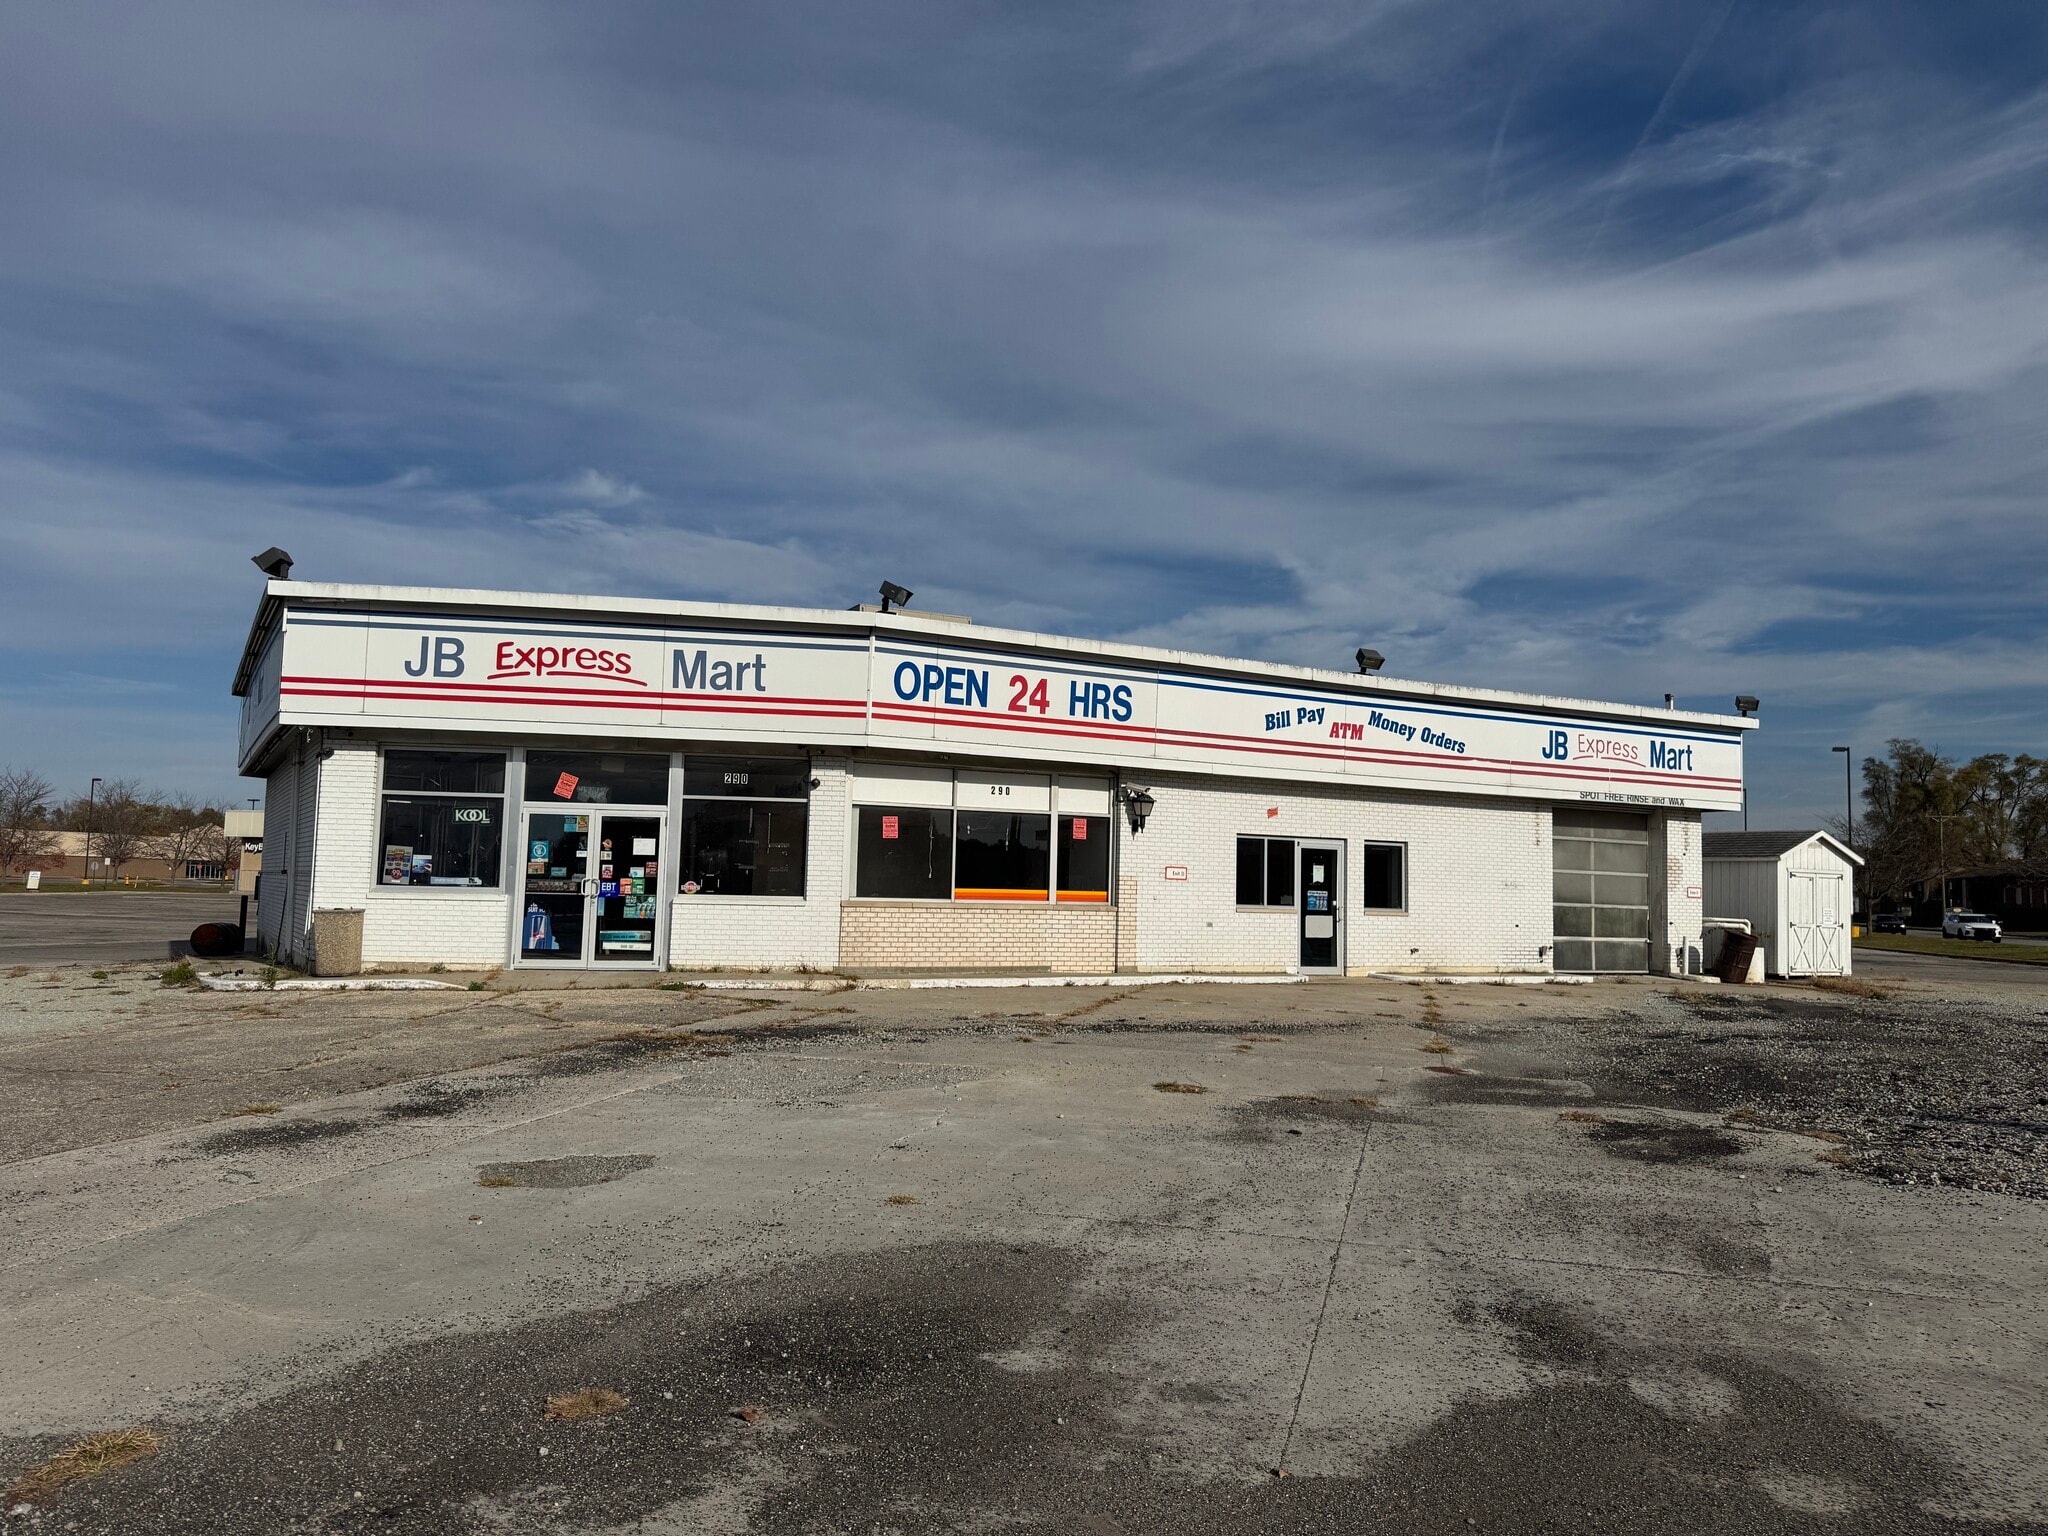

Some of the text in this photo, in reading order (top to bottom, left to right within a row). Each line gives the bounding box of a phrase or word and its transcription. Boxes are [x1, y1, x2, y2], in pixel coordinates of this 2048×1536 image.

[404, 636, 768, 692] JB Express Mart
[893, 661, 1133, 722] OPEN 24 HRS
[1264, 707, 1325, 731] Bill Pay
[1329, 722, 1364, 741] ATM
[1367, 710, 1466, 754] Money Orders
[1542, 730, 1693, 771] JB Express Mart
[724, 773, 749, 785] 290
[990, 785, 1011, 796] 290
[1580, 791, 1685, 806] SPOT FREE RINSE and WAX
[455, 809, 490, 824] KOOL
[601, 882, 617, 891] EBT
